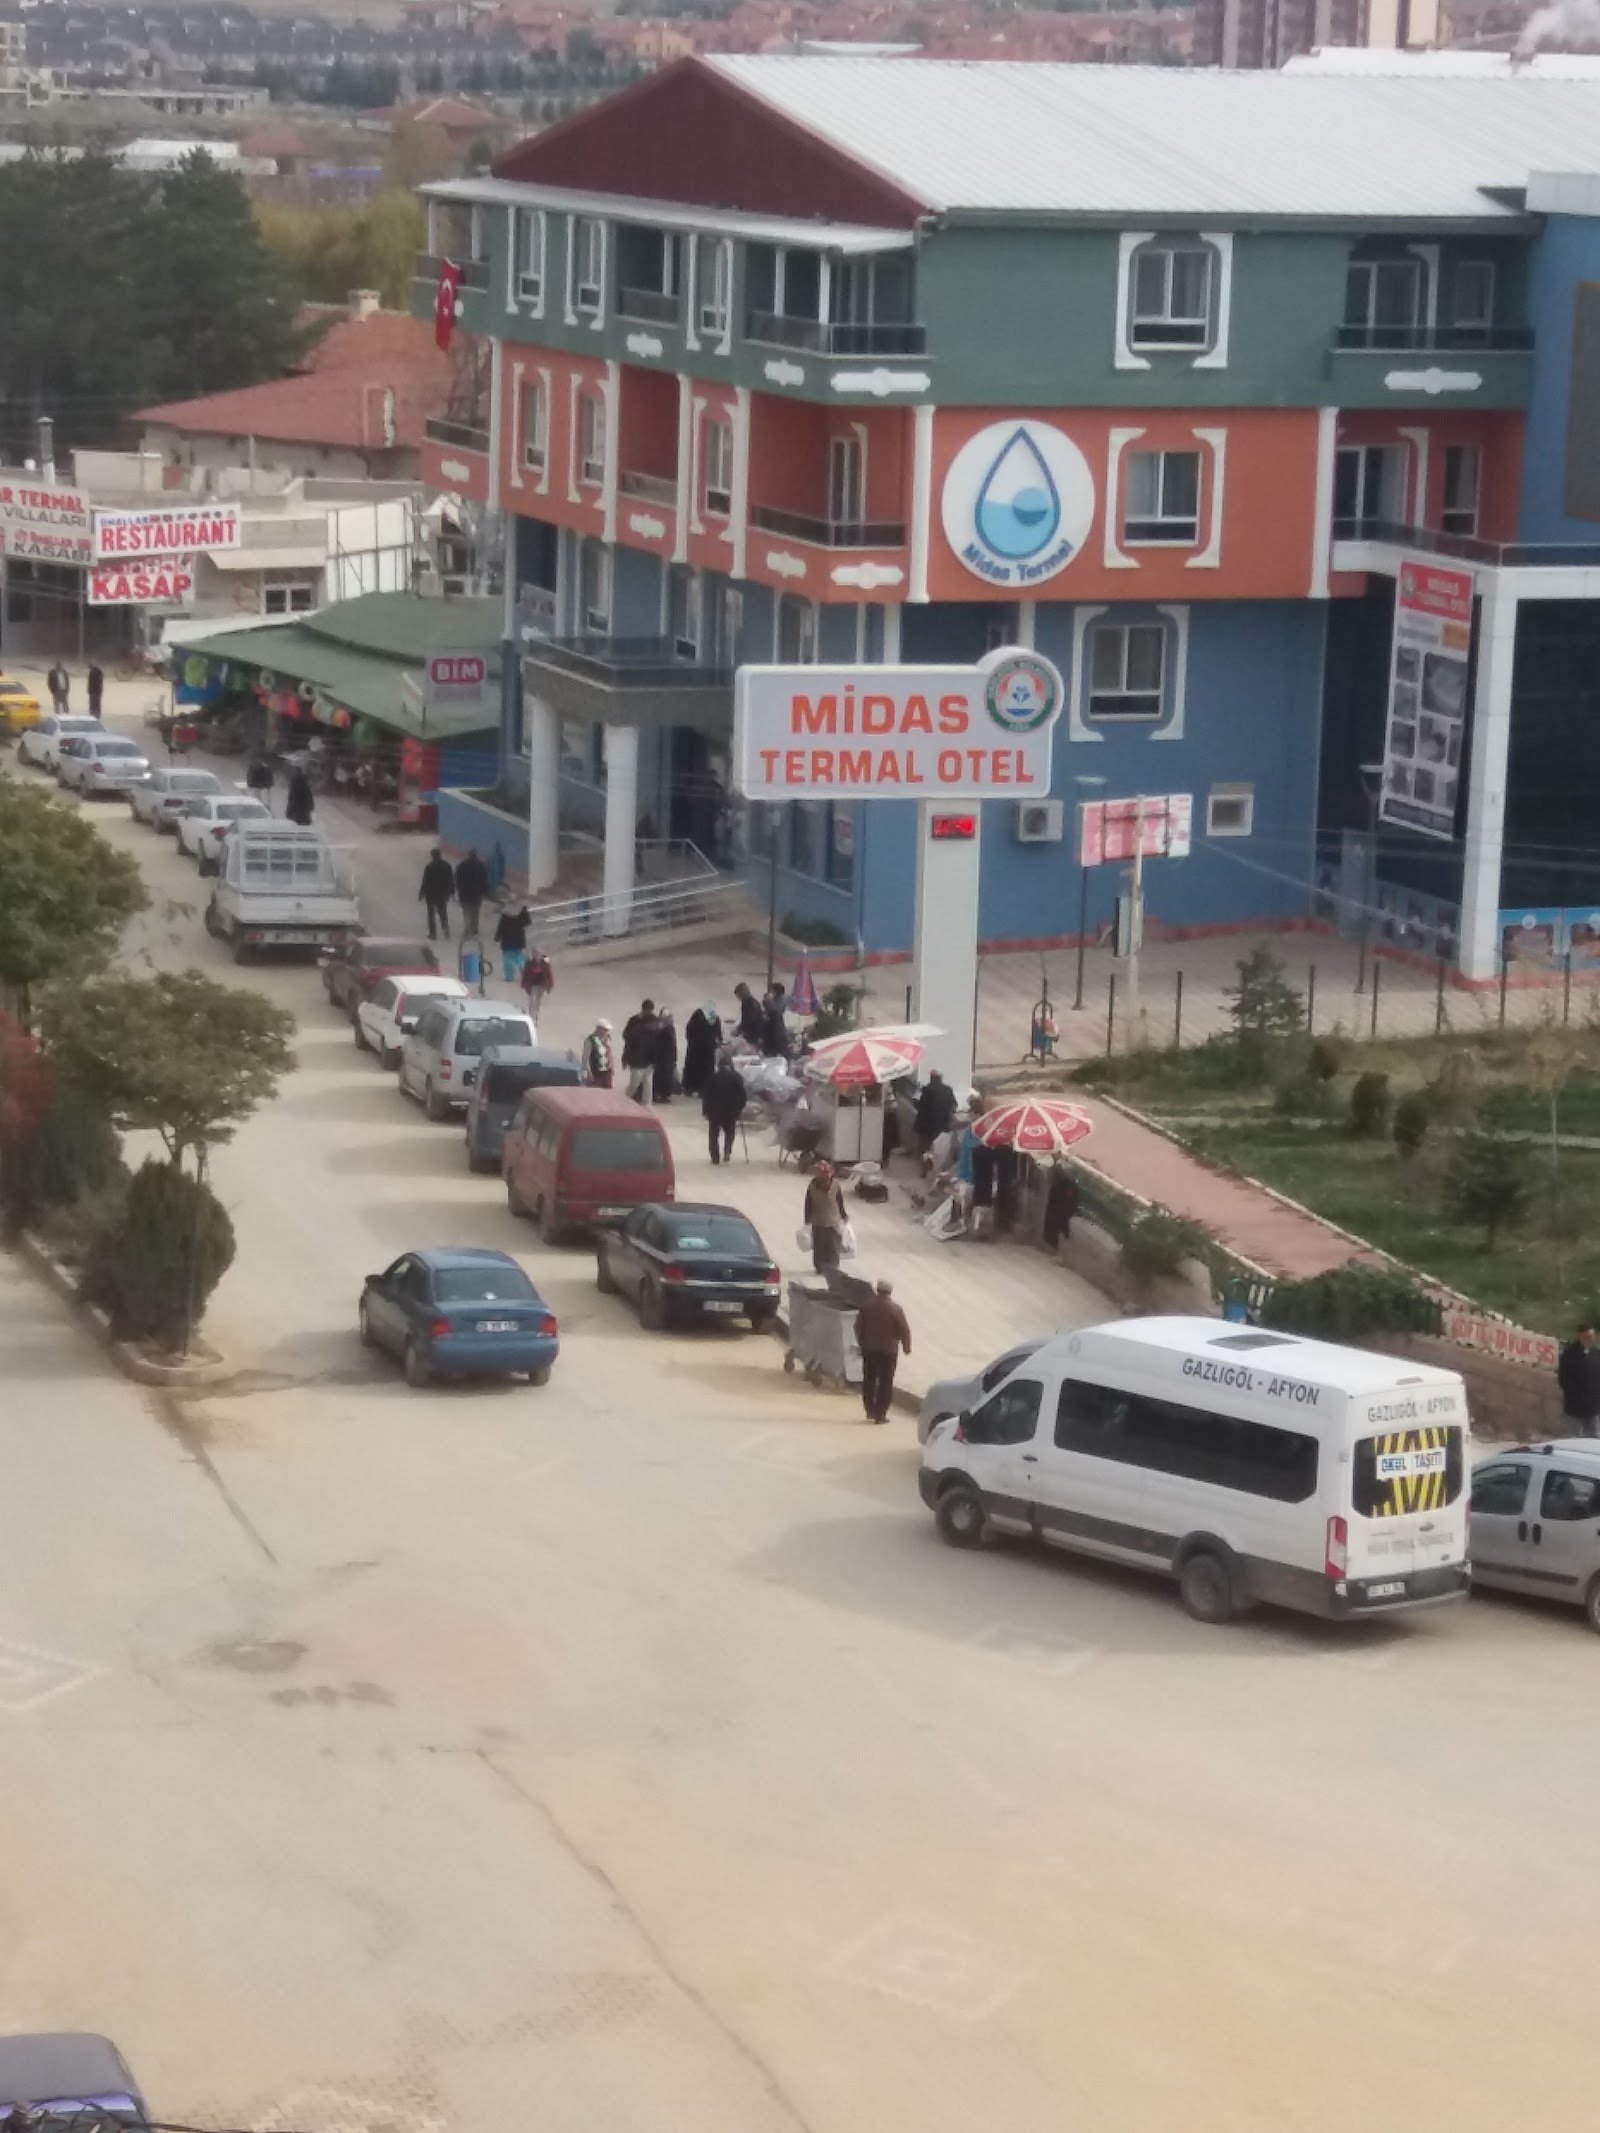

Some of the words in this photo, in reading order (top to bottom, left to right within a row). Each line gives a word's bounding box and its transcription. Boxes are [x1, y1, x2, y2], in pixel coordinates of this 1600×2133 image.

[19, 489, 84, 513] TERMAL
[102, 519, 236, 551] RESTAURANT
[92, 575, 191, 600] KASAP
[790, 684, 970, 734] MİDAS
[760, 750, 924, 785] TERMAL
[937, 750, 1034, 784] OTEL
[1182, 1358, 1253, 1391] GAZLIGÖL
[1267, 1381, 1321, 1405] AFYON
